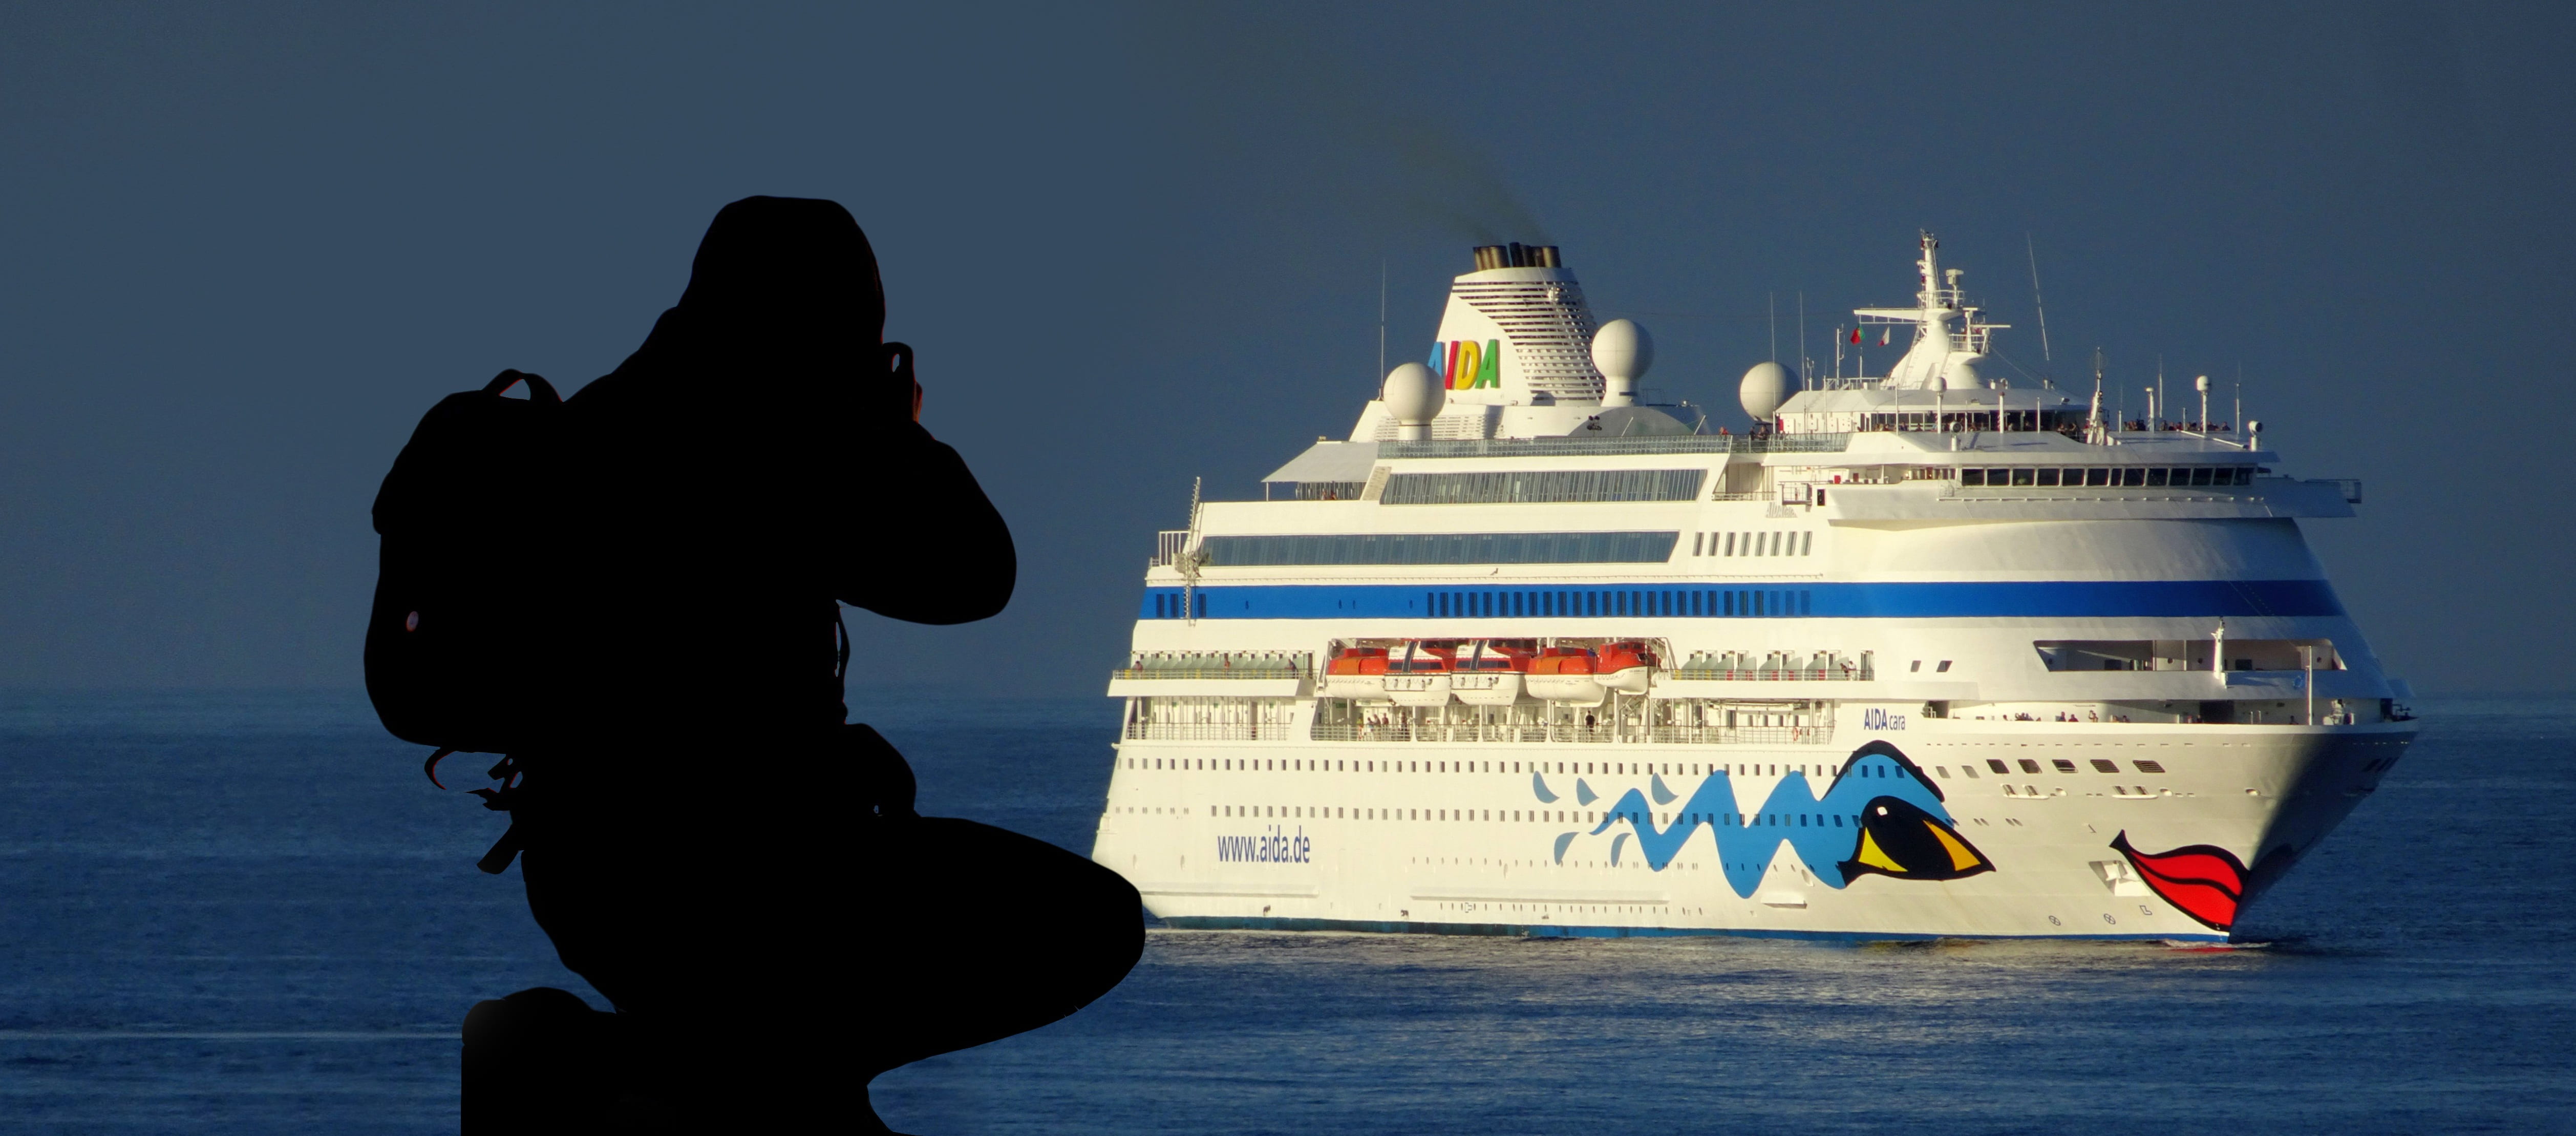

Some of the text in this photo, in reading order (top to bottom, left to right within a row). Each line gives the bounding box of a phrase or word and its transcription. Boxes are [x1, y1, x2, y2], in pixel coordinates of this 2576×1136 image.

[1864, 708, 1905, 730] AIDA cara
[1218, 824, 1310, 864] www.aida.de
